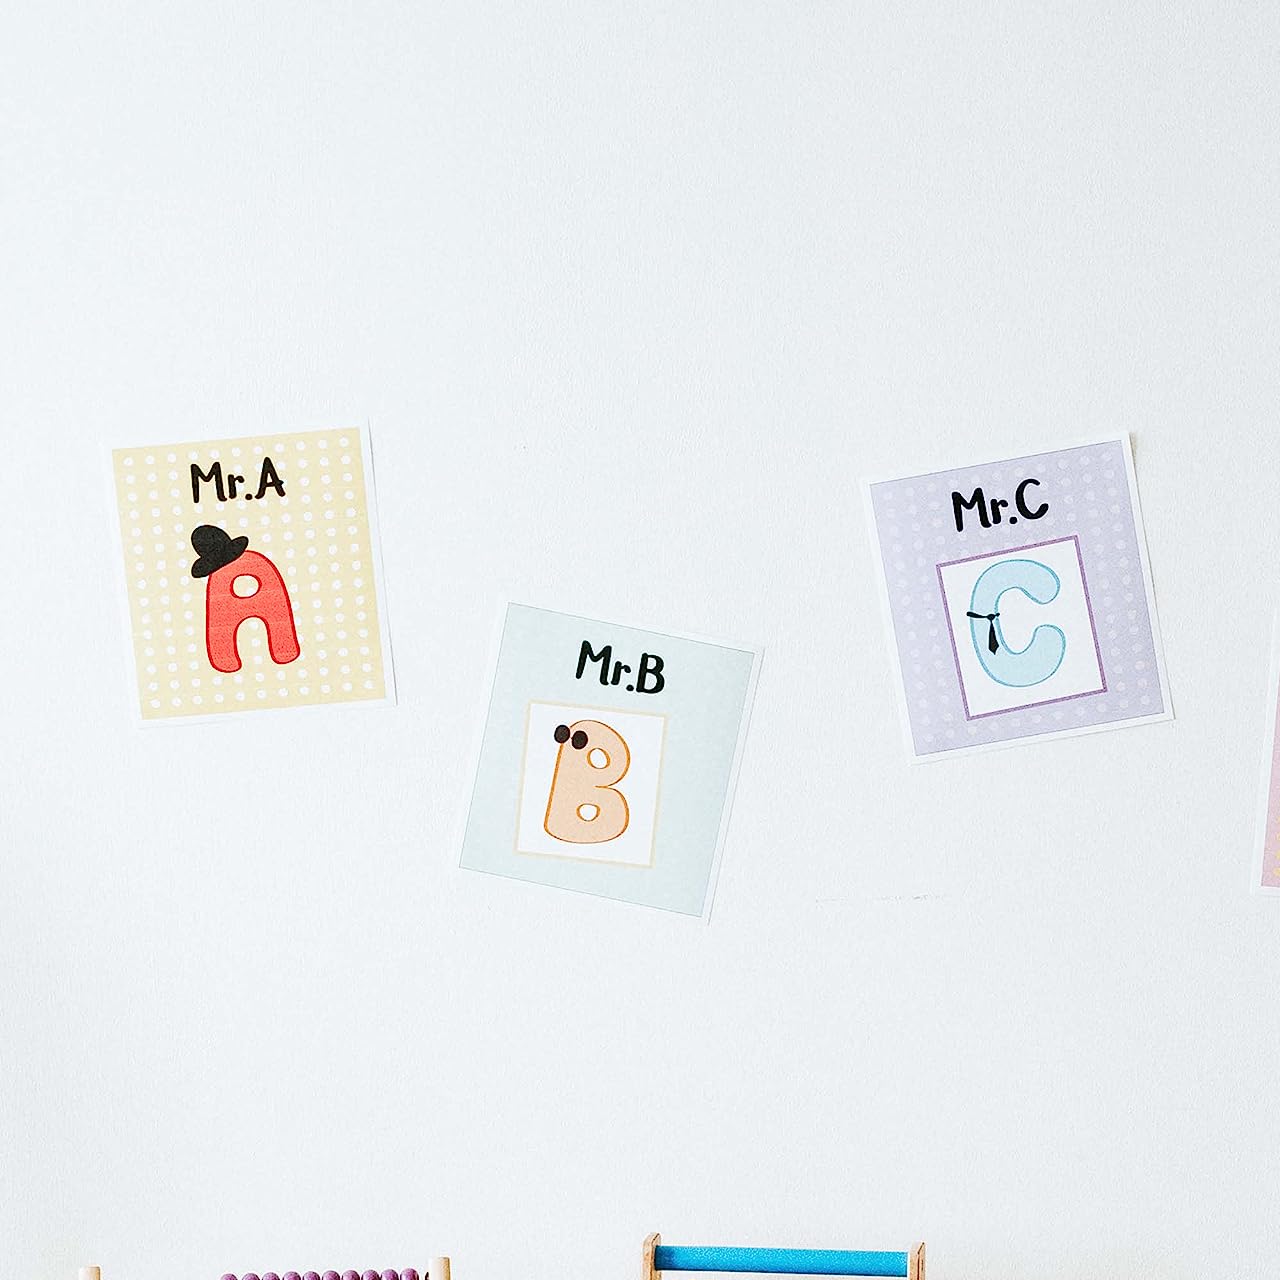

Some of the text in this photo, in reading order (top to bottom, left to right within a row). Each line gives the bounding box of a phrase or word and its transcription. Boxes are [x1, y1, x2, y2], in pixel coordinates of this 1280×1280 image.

[191, 457, 285, 503] Mr.A
[952, 479, 1048, 531] Mr.C
[206, 549, 301, 673] A
[970, 559, 1066, 688] C
[576, 641, 664, 693] Mr.B
[543, 719, 630, 844] B
